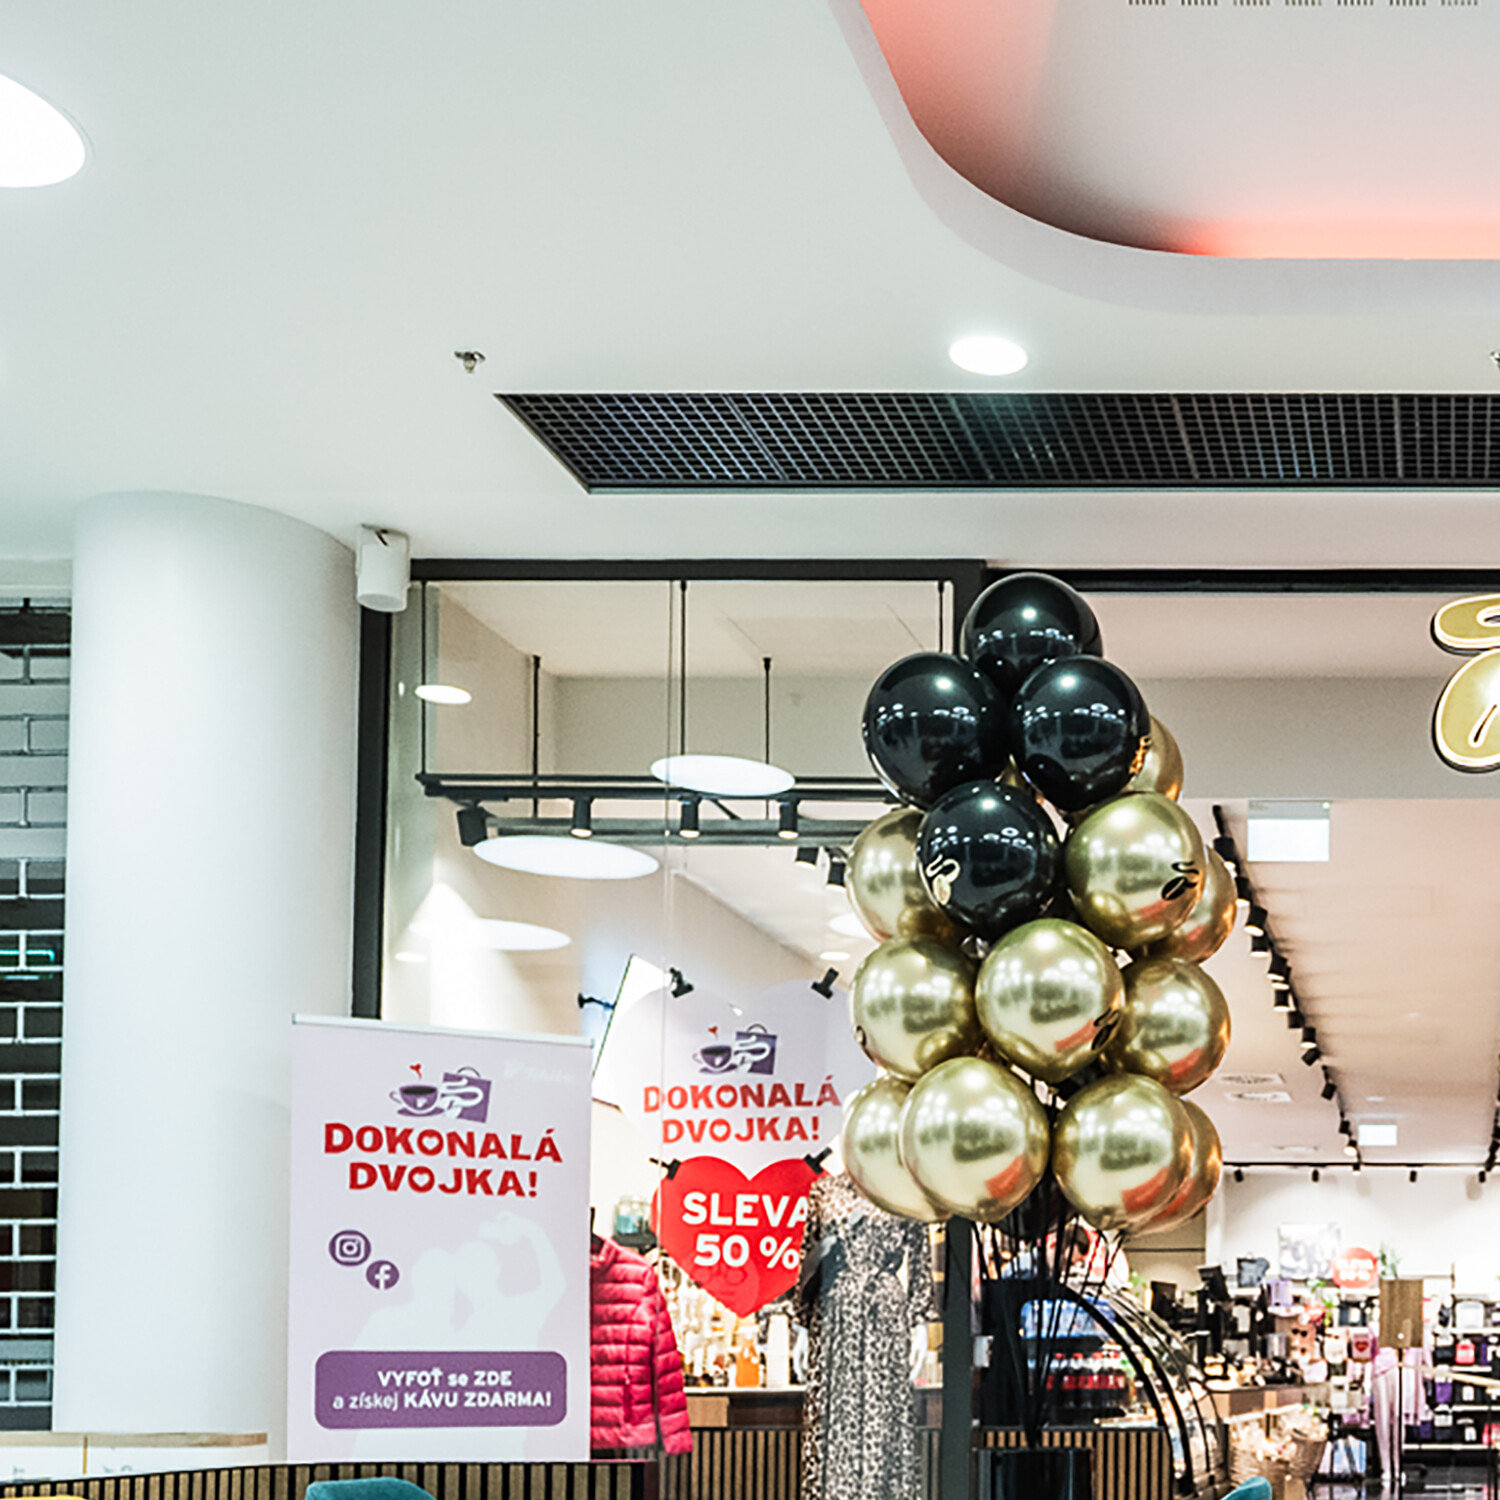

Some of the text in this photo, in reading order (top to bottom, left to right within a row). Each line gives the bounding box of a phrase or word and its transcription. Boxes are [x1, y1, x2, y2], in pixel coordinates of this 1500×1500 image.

[643, 1075, 842, 1113] DOKONALÁ
[324, 1122, 563, 1164] DOKONALÁ
[662, 1116, 820, 1144] DVOJKA!
[348, 1162, 538, 1198] DVOJKA!
[682, 1191, 809, 1228] SLEVA
[694, 1233, 800, 1270] 50 %
[377, 1367, 513, 1387] VYFOŤ se ZDE
[332, 1388, 552, 1411] a získej KÁVU ZDARMA!
